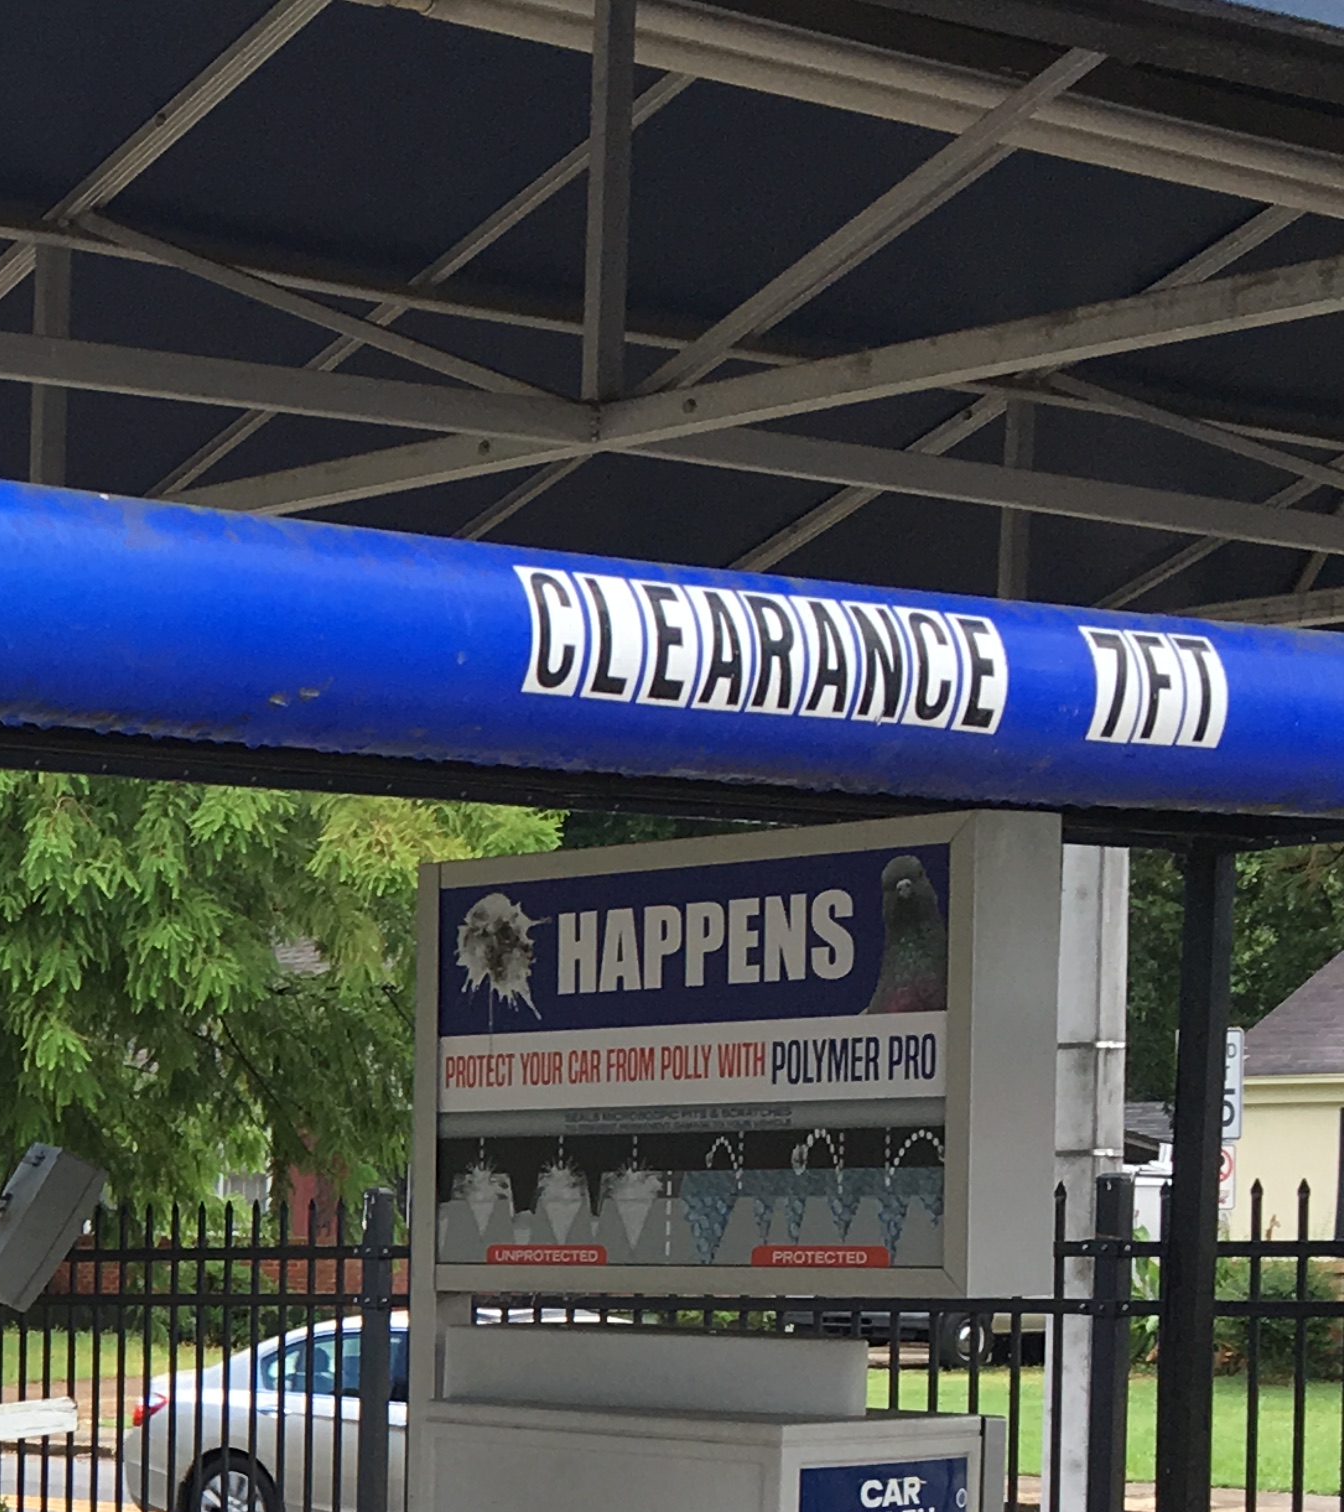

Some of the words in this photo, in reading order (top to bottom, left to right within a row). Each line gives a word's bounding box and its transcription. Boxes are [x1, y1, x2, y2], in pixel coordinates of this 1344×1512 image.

[526, 569, 999, 732] CLEARANCE
[1089, 632, 1219, 744] 7FT
[557, 889, 855, 996] HAPPENS
[445, 1053, 515, 1089] PROTECT
[520, 1051, 562, 1086] YOUR
[568, 1049, 601, 1085] CAR
[606, 1047, 655, 1083] FROM
[661, 1045, 711, 1081] POLLY
[717, 1041, 766, 1078] WITH
[772, 1036, 880, 1085] POLYMER
[888, 1033, 936, 1081] PRO
[495, 1249, 598, 1263] UNPROTECTED
[772, 1251, 868, 1265] PROTECTED
[860, 1476, 921, 1508] CAR
